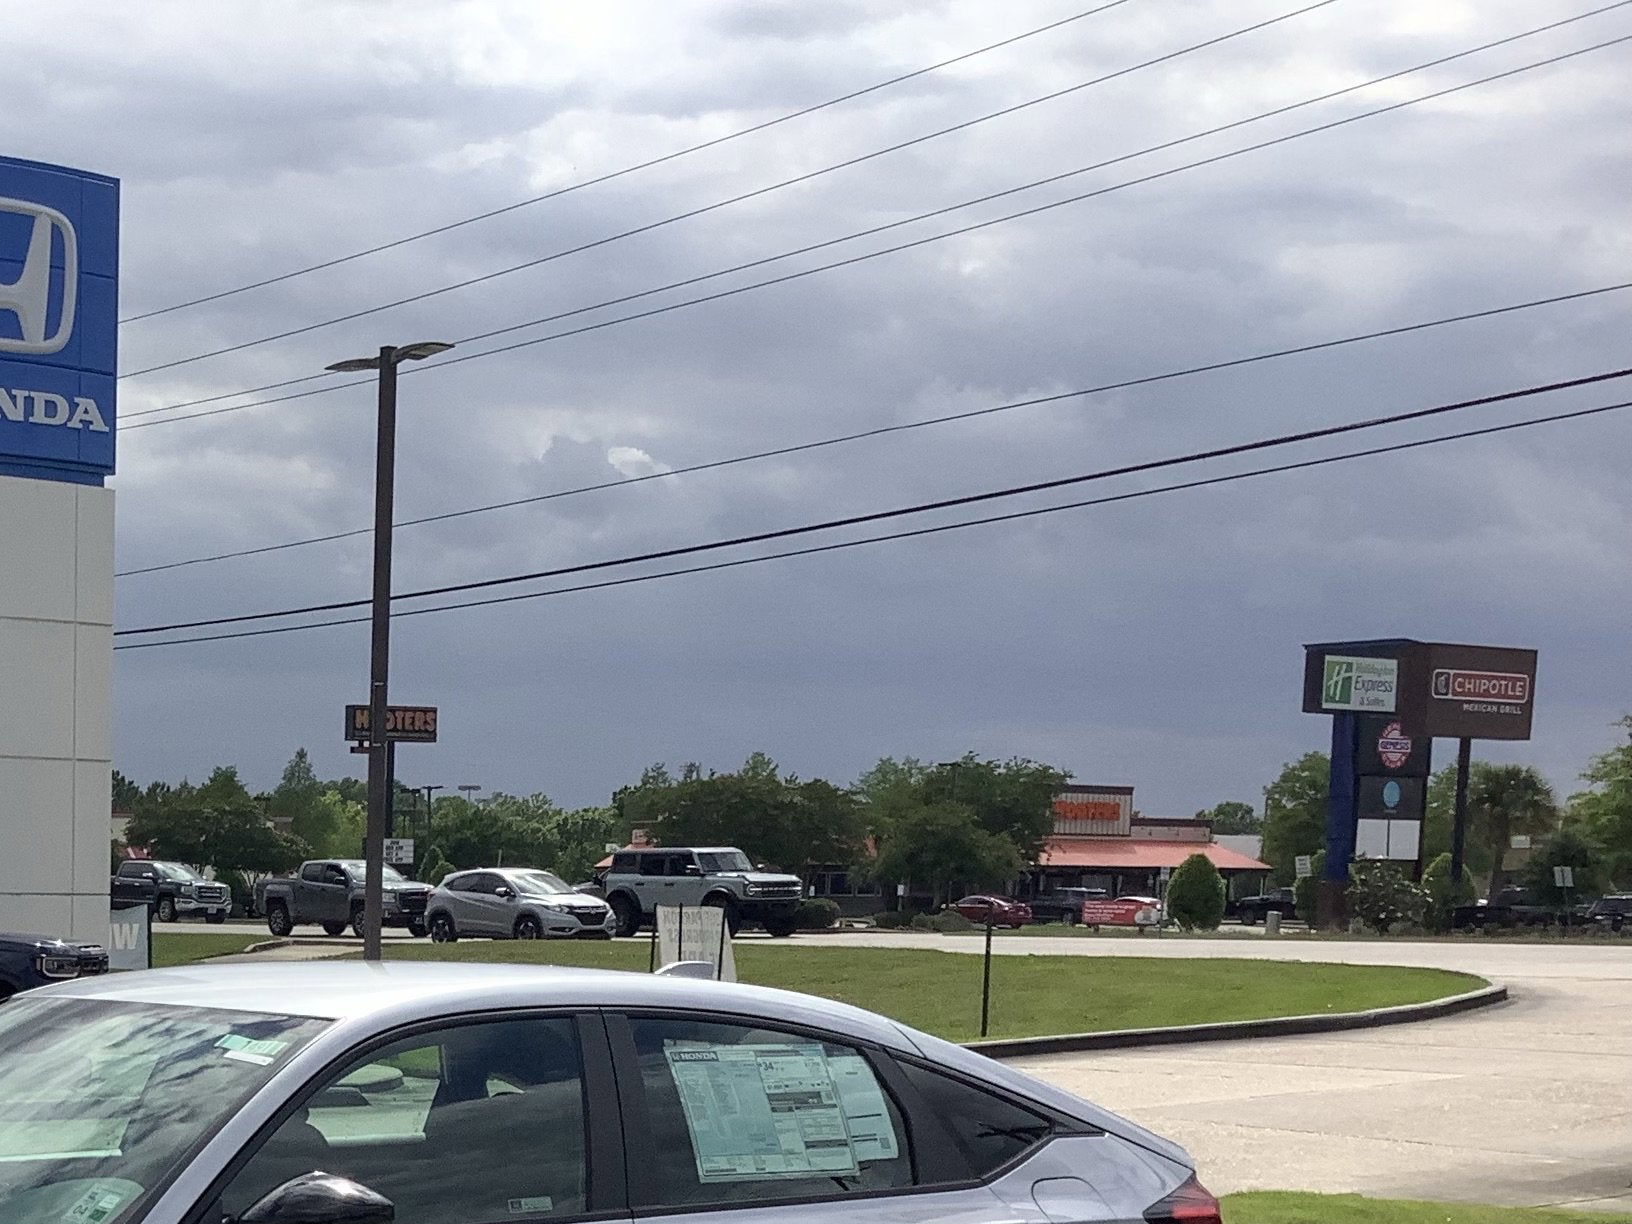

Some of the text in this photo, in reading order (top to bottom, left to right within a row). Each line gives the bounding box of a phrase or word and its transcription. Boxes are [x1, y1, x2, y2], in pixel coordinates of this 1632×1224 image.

[1354, 675, 1393, 695] Express
[1454, 678, 1524, 696] CHIPOTLE
[355, 709, 435, 731] HOTERS
[680, 1052, 718, 1060] HONDA
